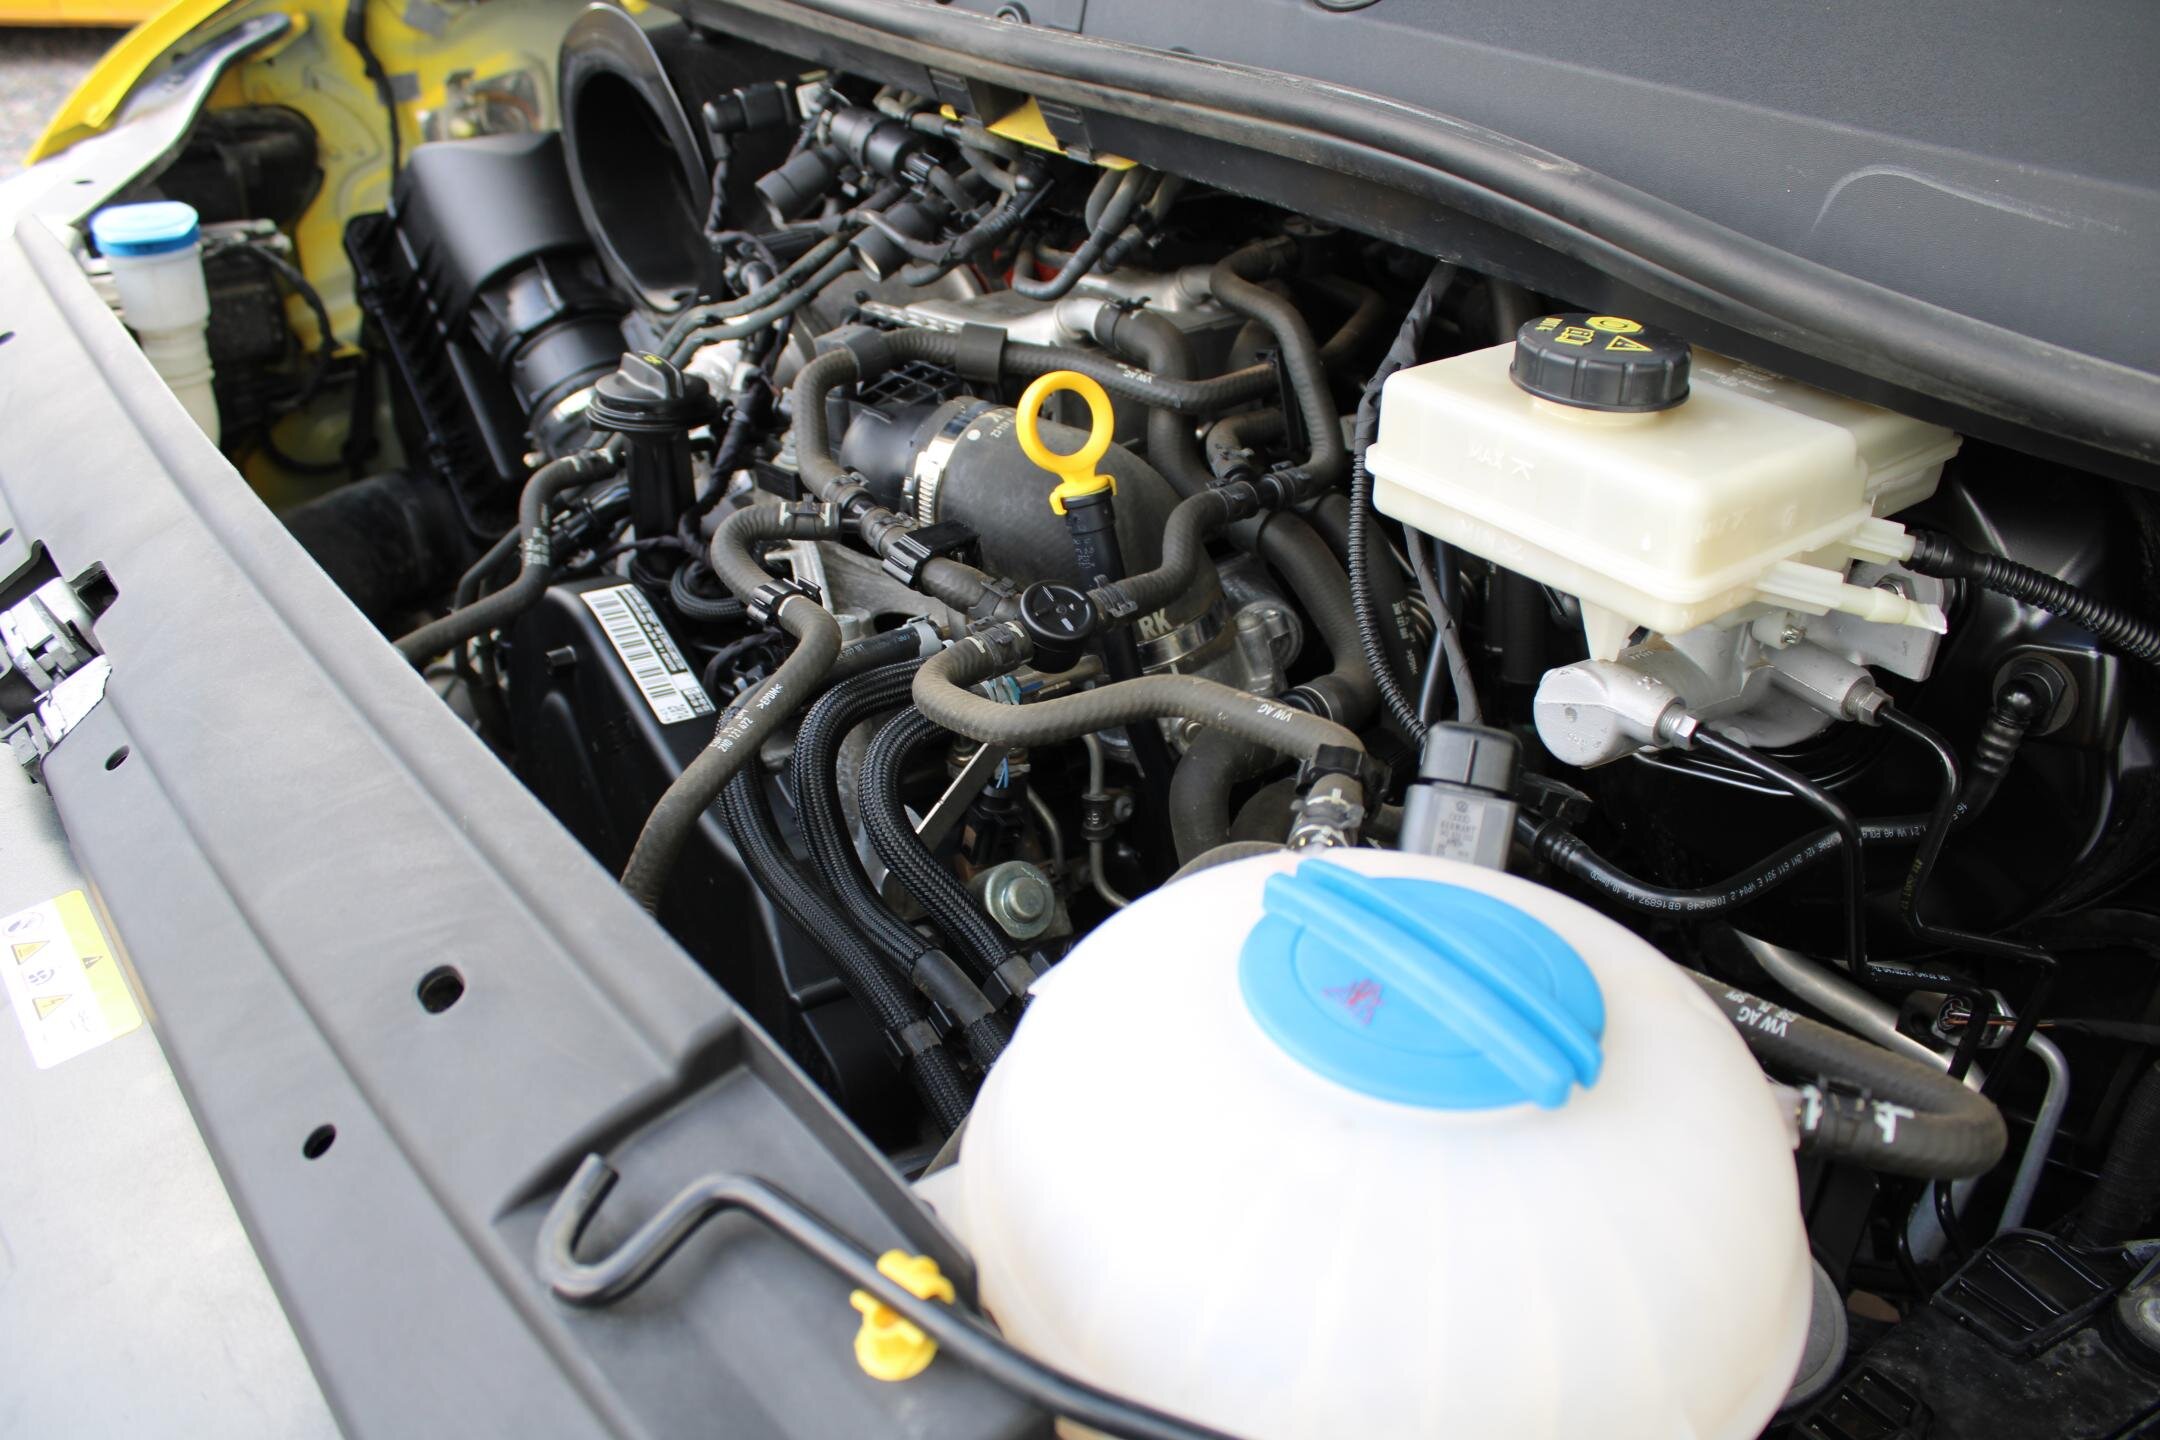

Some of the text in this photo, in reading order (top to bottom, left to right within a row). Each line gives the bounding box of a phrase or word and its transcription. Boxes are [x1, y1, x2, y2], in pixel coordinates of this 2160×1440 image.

[1256, 702, 1275, 716] AG
[1273, 707, 1292, 722] VW
[1736, 1006, 1787, 1037] VW AG
